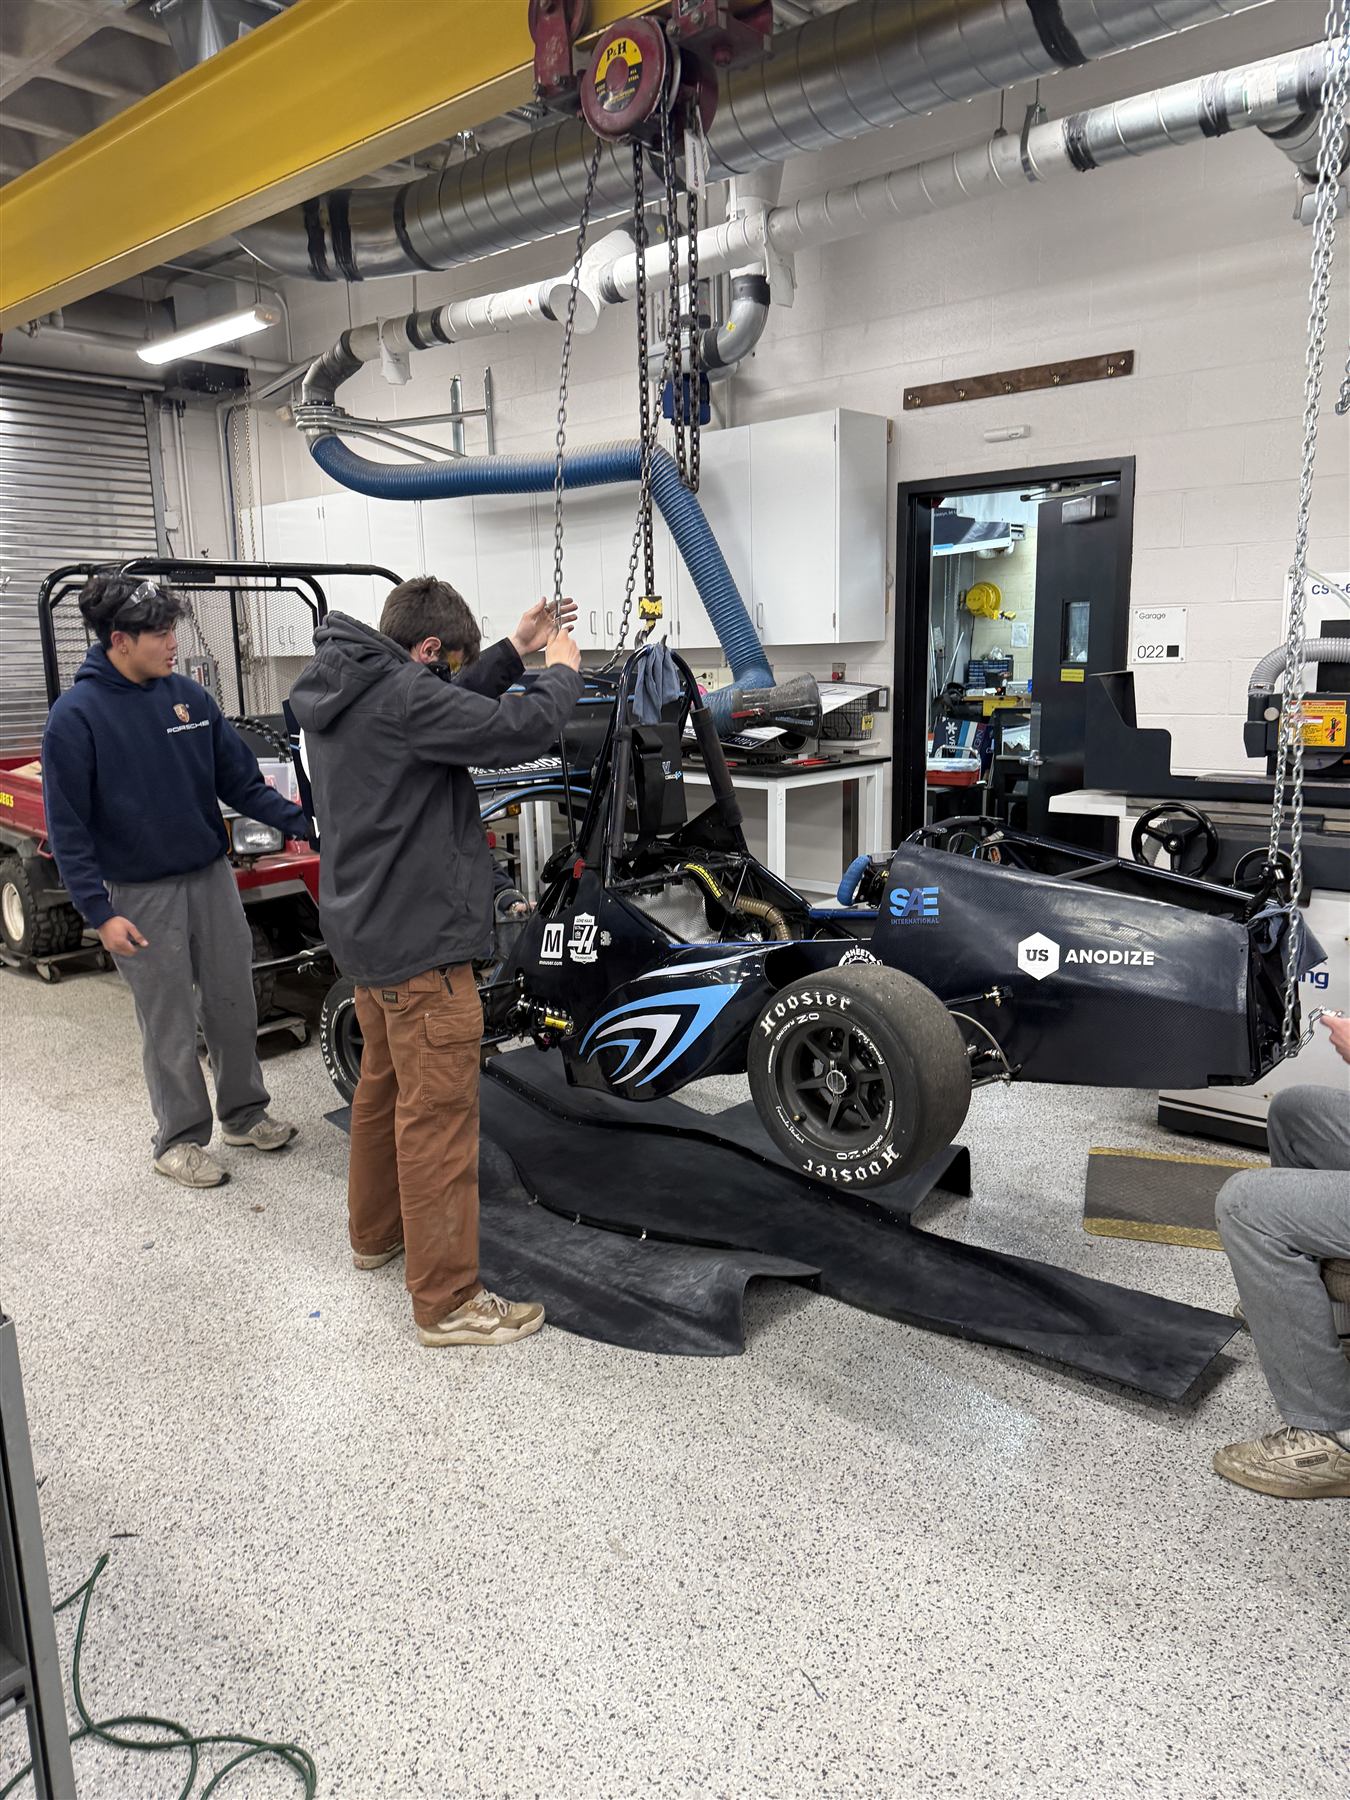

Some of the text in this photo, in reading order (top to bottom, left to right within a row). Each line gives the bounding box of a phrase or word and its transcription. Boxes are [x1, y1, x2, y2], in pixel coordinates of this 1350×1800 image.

[606, 40, 628, 61] P&H
[1138, 612, 1166, 620] Garage
[1137, 645, 1164, 659] 022
[166, 719, 210, 734] PORSCHE
[890, 886, 939, 917] SAE
[891, 917, 940, 925] INTERNATIONAL
[544, 929, 561, 953] M
[845, 948, 870, 959] SHEET
[1026, 949, 1154, 966] US ANODIZE
[760, 992, 850, 1037] Hoosier
[775, 1019, 795, 1041] RACING
[862, 1134, 884, 1156] RACING
[802, 1143, 900, 1183] Hoosier
